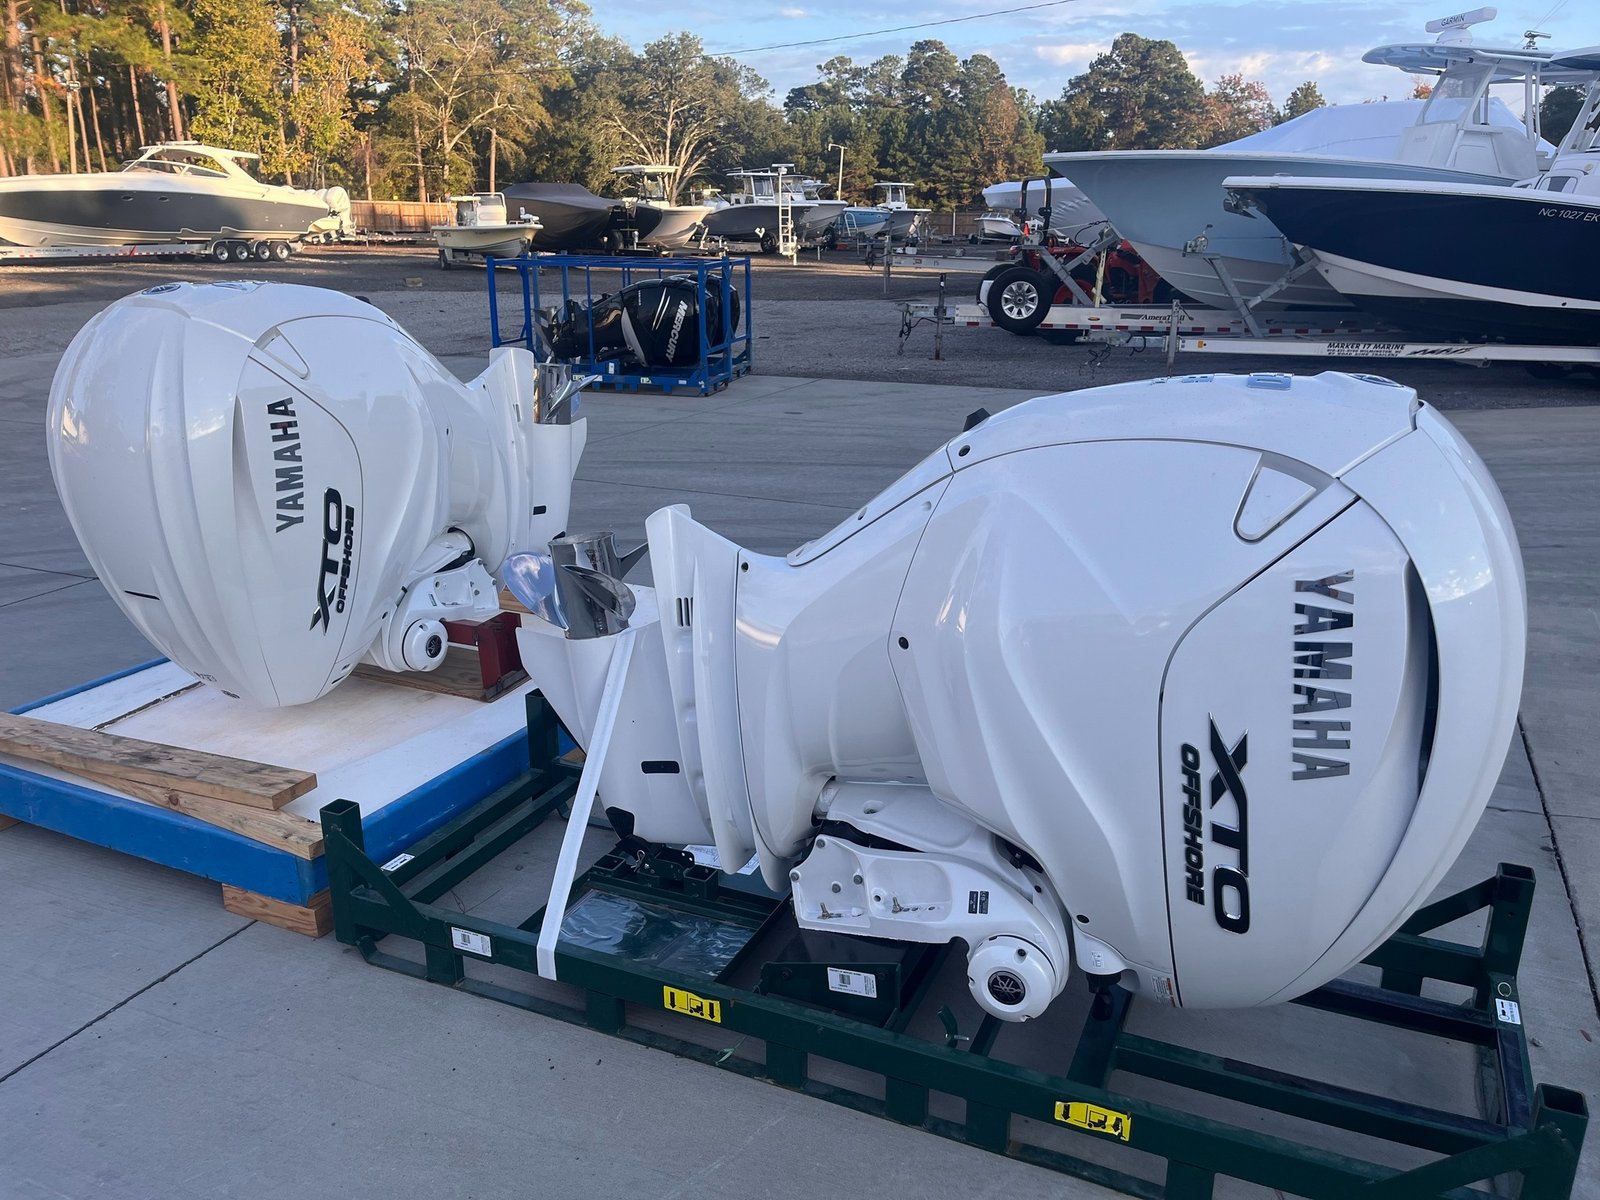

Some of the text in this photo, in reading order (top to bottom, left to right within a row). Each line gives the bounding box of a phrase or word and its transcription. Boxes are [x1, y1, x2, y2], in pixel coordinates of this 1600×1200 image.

[1441, 14, 1465, 26] GARMIN
[1538, 207, 1600, 222] NC 1027 EK
[665, 300, 688, 363] MERCURY
[1373, 343, 1406, 351] MARINE
[267, 397, 304, 533] YAMAHA
[309, 486, 342, 636] XTO
[336, 504, 355, 614] OFFSHORE
[1292, 569, 1354, 781] YAMAHA
[1180, 742, 1205, 905] OFFSHORE
[1208, 712, 1250, 934] XTO
